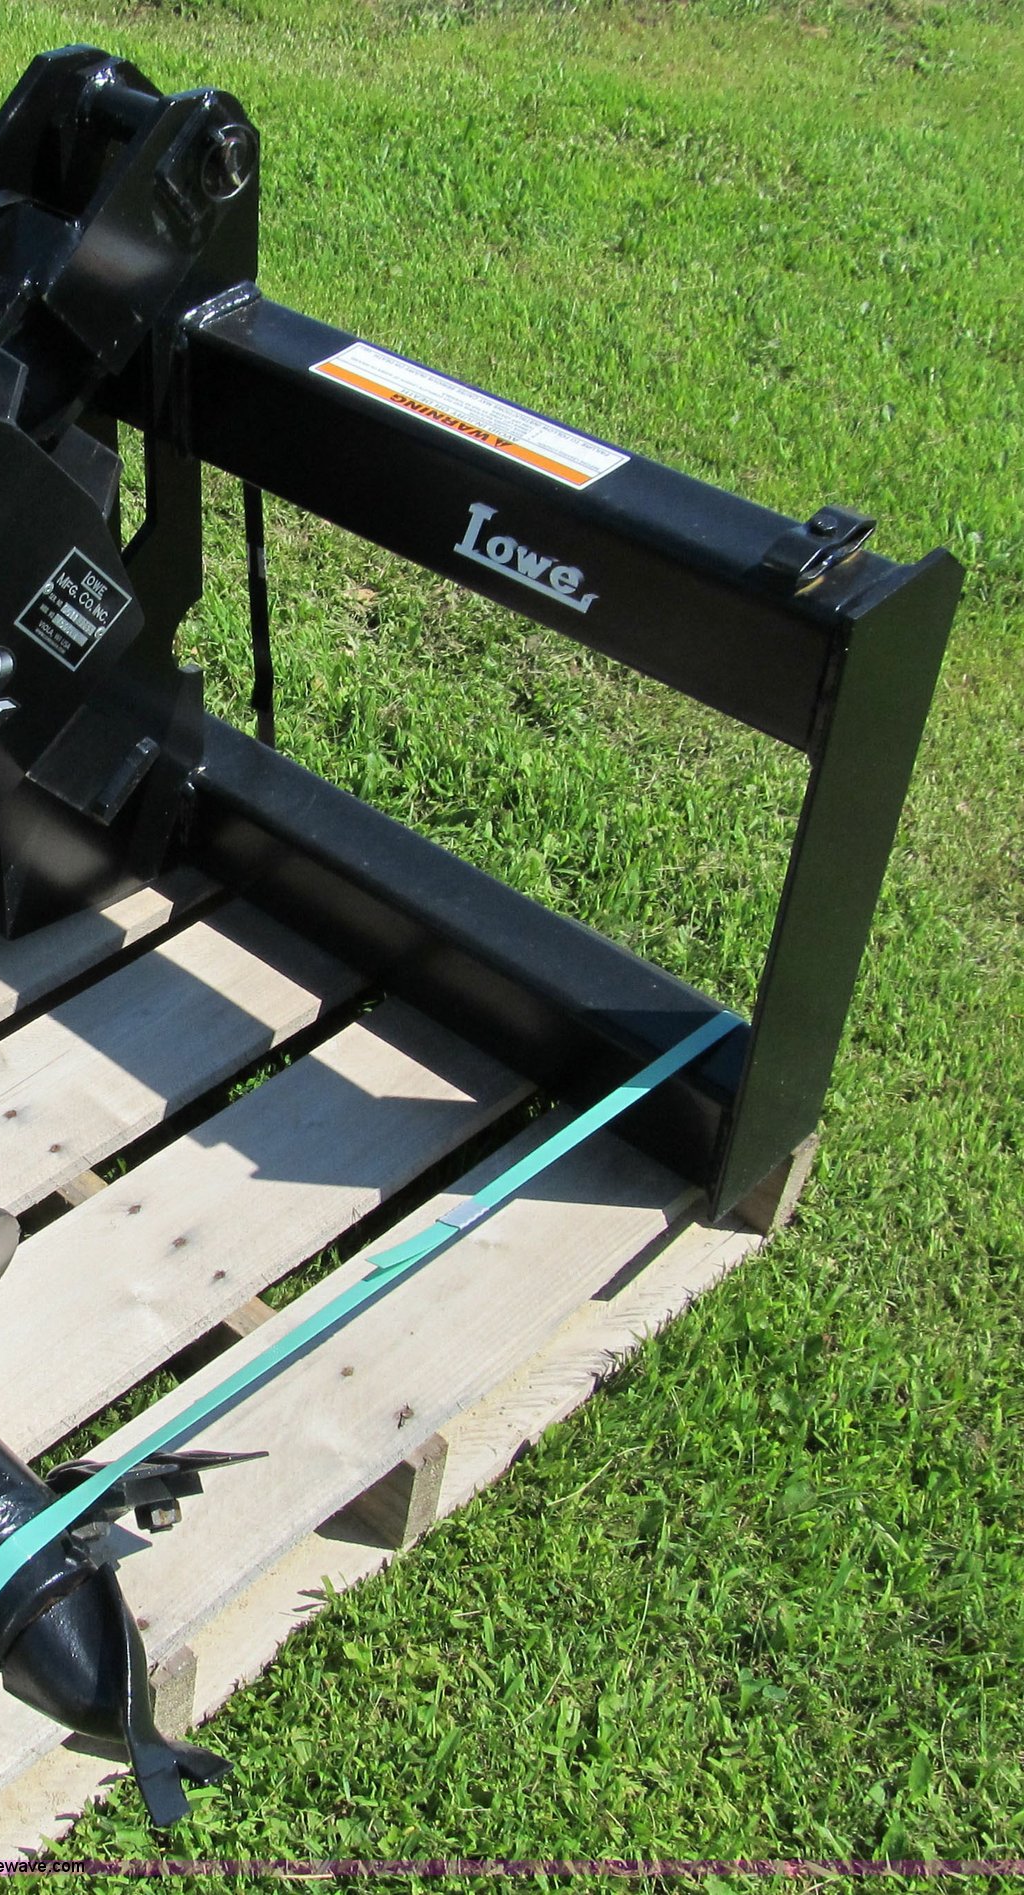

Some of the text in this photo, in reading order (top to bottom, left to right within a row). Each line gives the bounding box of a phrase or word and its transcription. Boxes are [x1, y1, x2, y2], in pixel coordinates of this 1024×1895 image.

[386, 394, 489, 441] WARNING
[454, 502, 599, 613] Lowe
[56, 572, 77, 598] MFG.
[78, 592, 93, 612] CO.
[92, 603, 107, 624] INC.
[80, 570, 108, 600] LOWE
